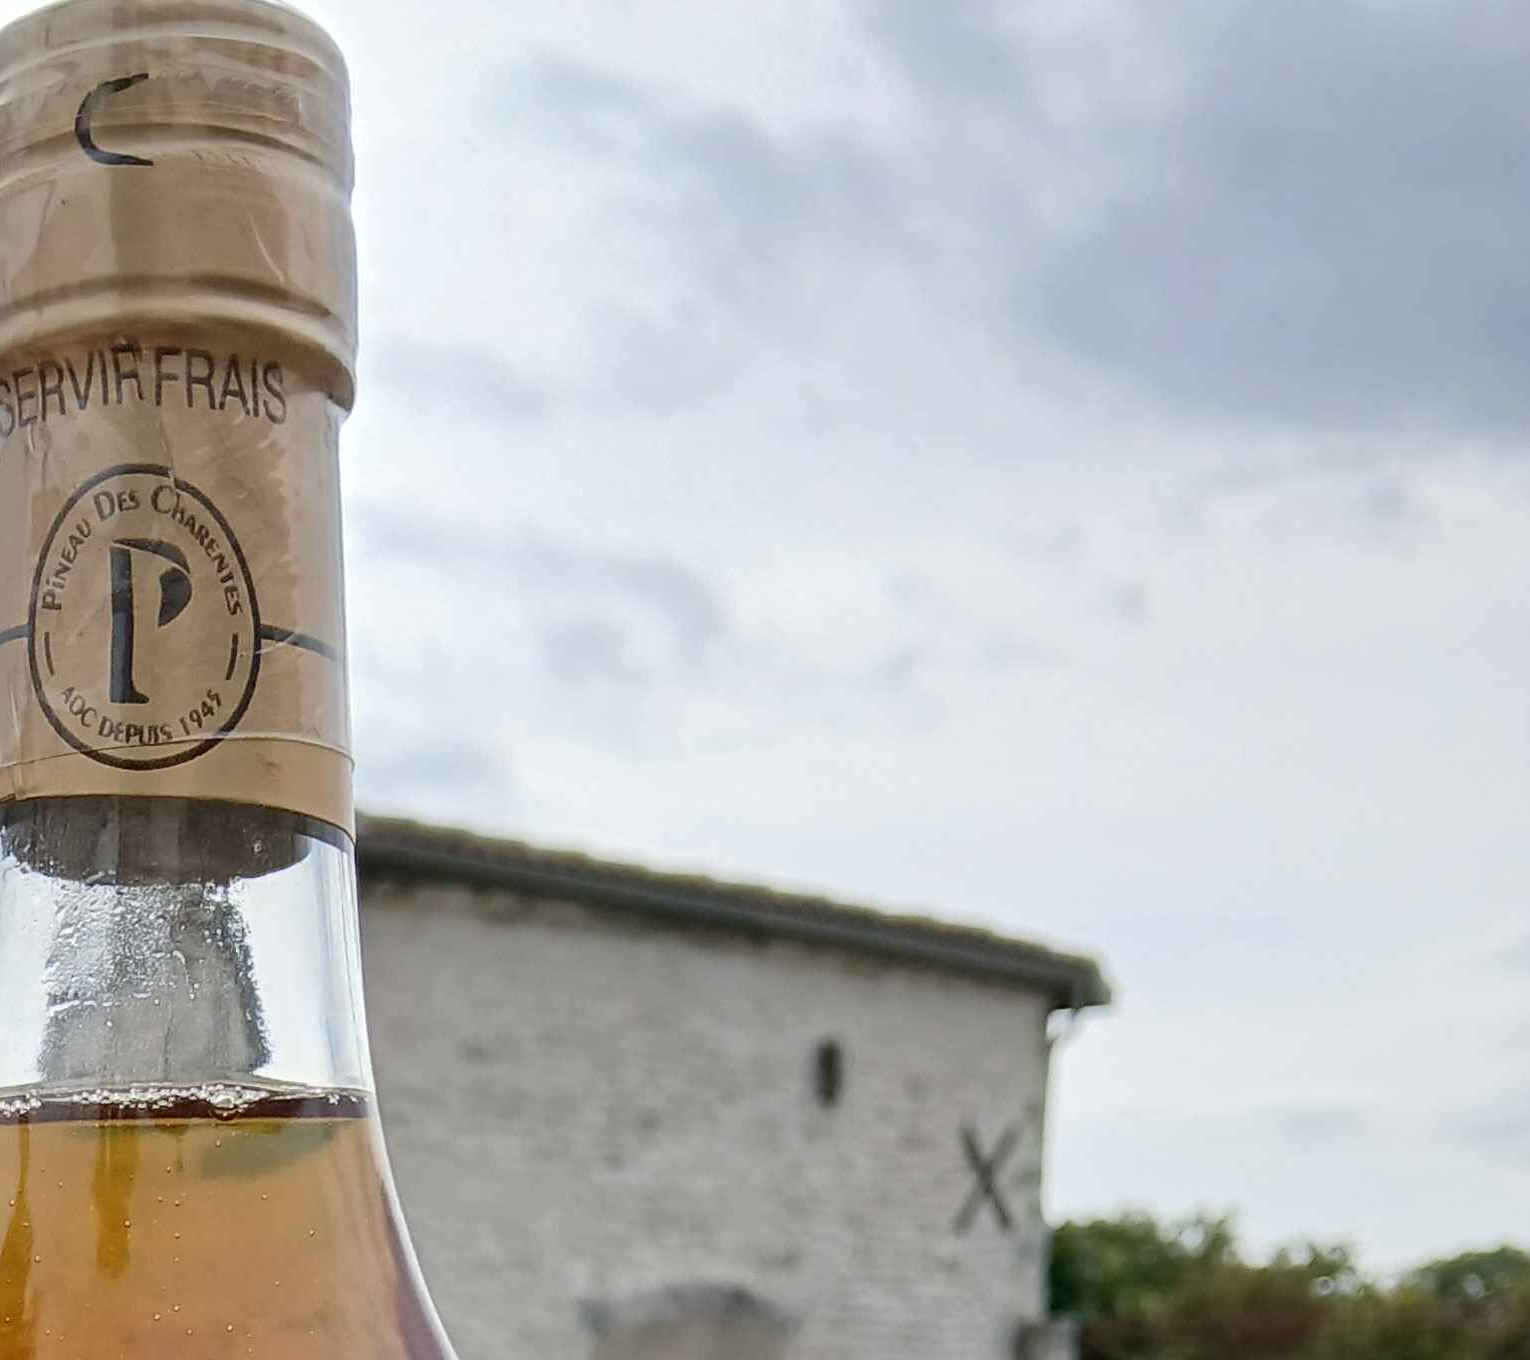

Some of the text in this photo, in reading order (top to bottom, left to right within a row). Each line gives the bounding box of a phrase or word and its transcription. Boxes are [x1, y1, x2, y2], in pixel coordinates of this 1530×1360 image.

[153, 347, 288, 426] FRAIS
[92, 488, 140, 522] DES
[108, 537, 193, 704] P
[98, 715, 172, 744] DEPUIS
